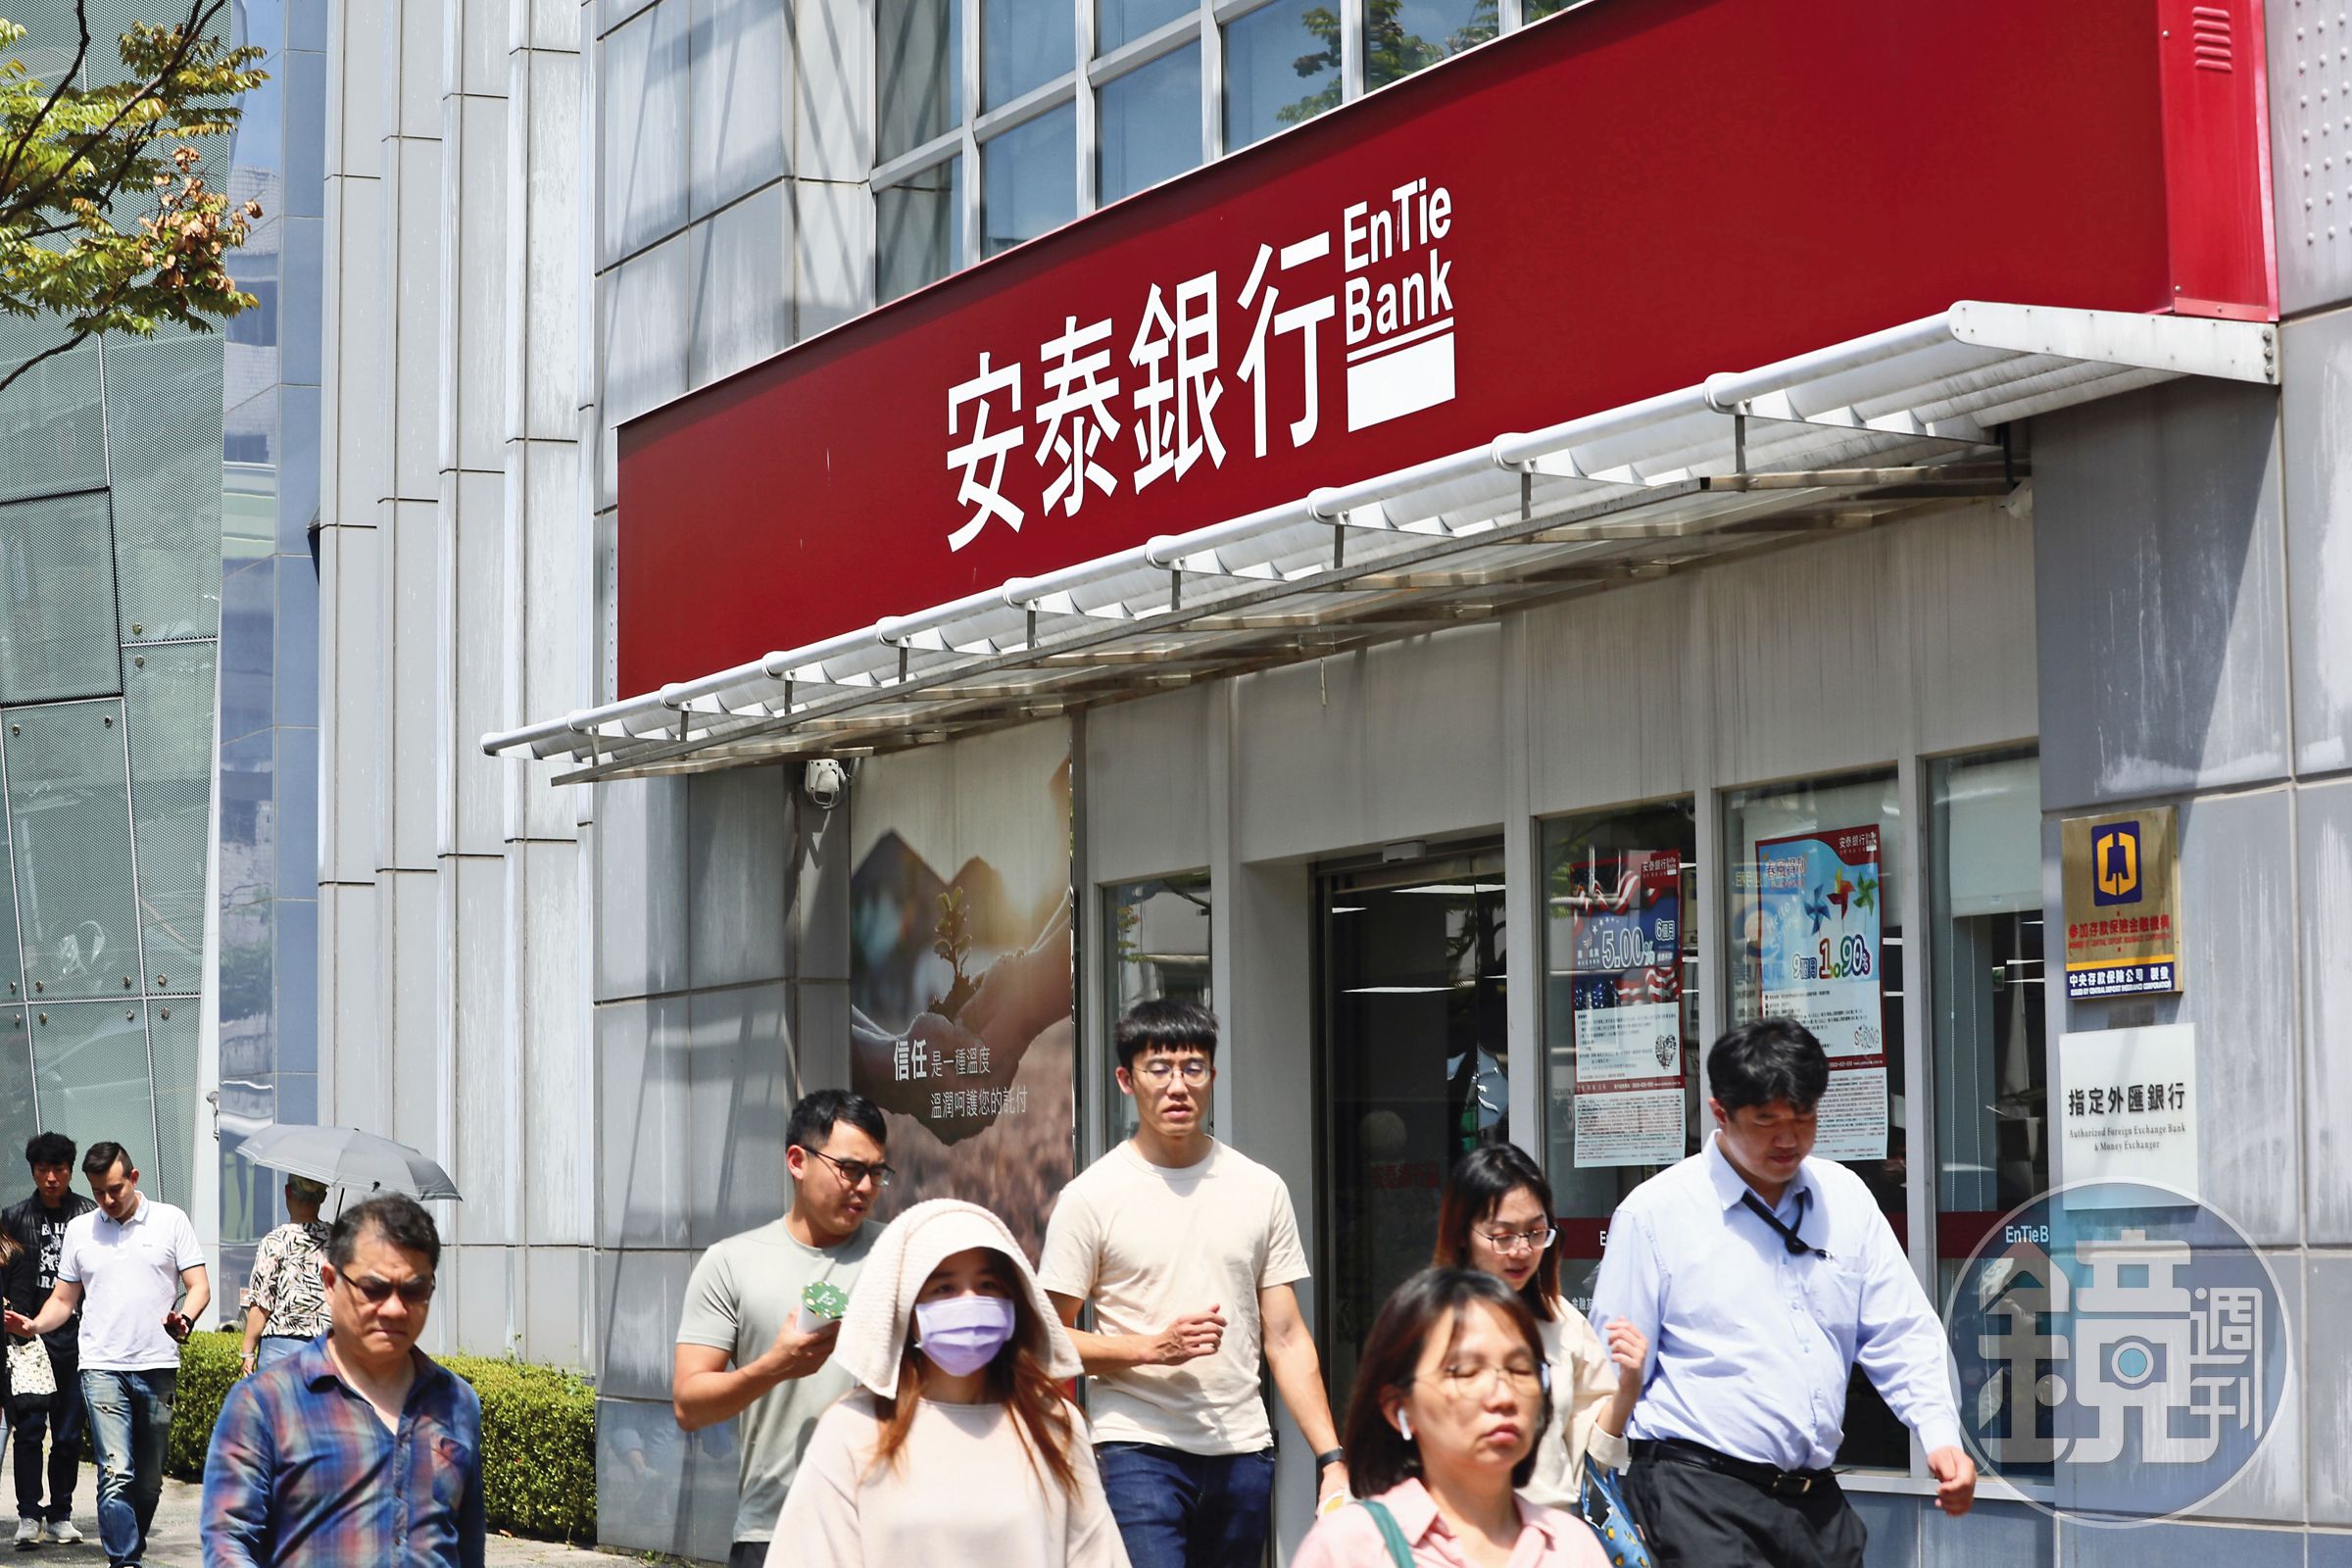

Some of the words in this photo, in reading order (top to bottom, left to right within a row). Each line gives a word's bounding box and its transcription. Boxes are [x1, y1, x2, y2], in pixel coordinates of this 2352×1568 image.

[1343, 176, 1452, 274] EnTie
[1346, 249, 1453, 346] Bank
[947, 231, 1336, 552] 安泰銀行
[1602, 926, 1656, 968] 5.00%
[930, 1085, 1028, 1119] 溫潤呵護您的託付
[2069, 1083, 2184, 1116] 指定外匯銀行
[2070, 1127, 2106, 1139] Authorized
[2107, 1126, 2132, 1139] Foreign
[2133, 1122, 2166, 1135] Exchange
[2168, 1122, 2185, 1133] Bank
[2100, 1142, 2122, 1152] Money
[2124, 1140, 2160, 1152] Exchanger
